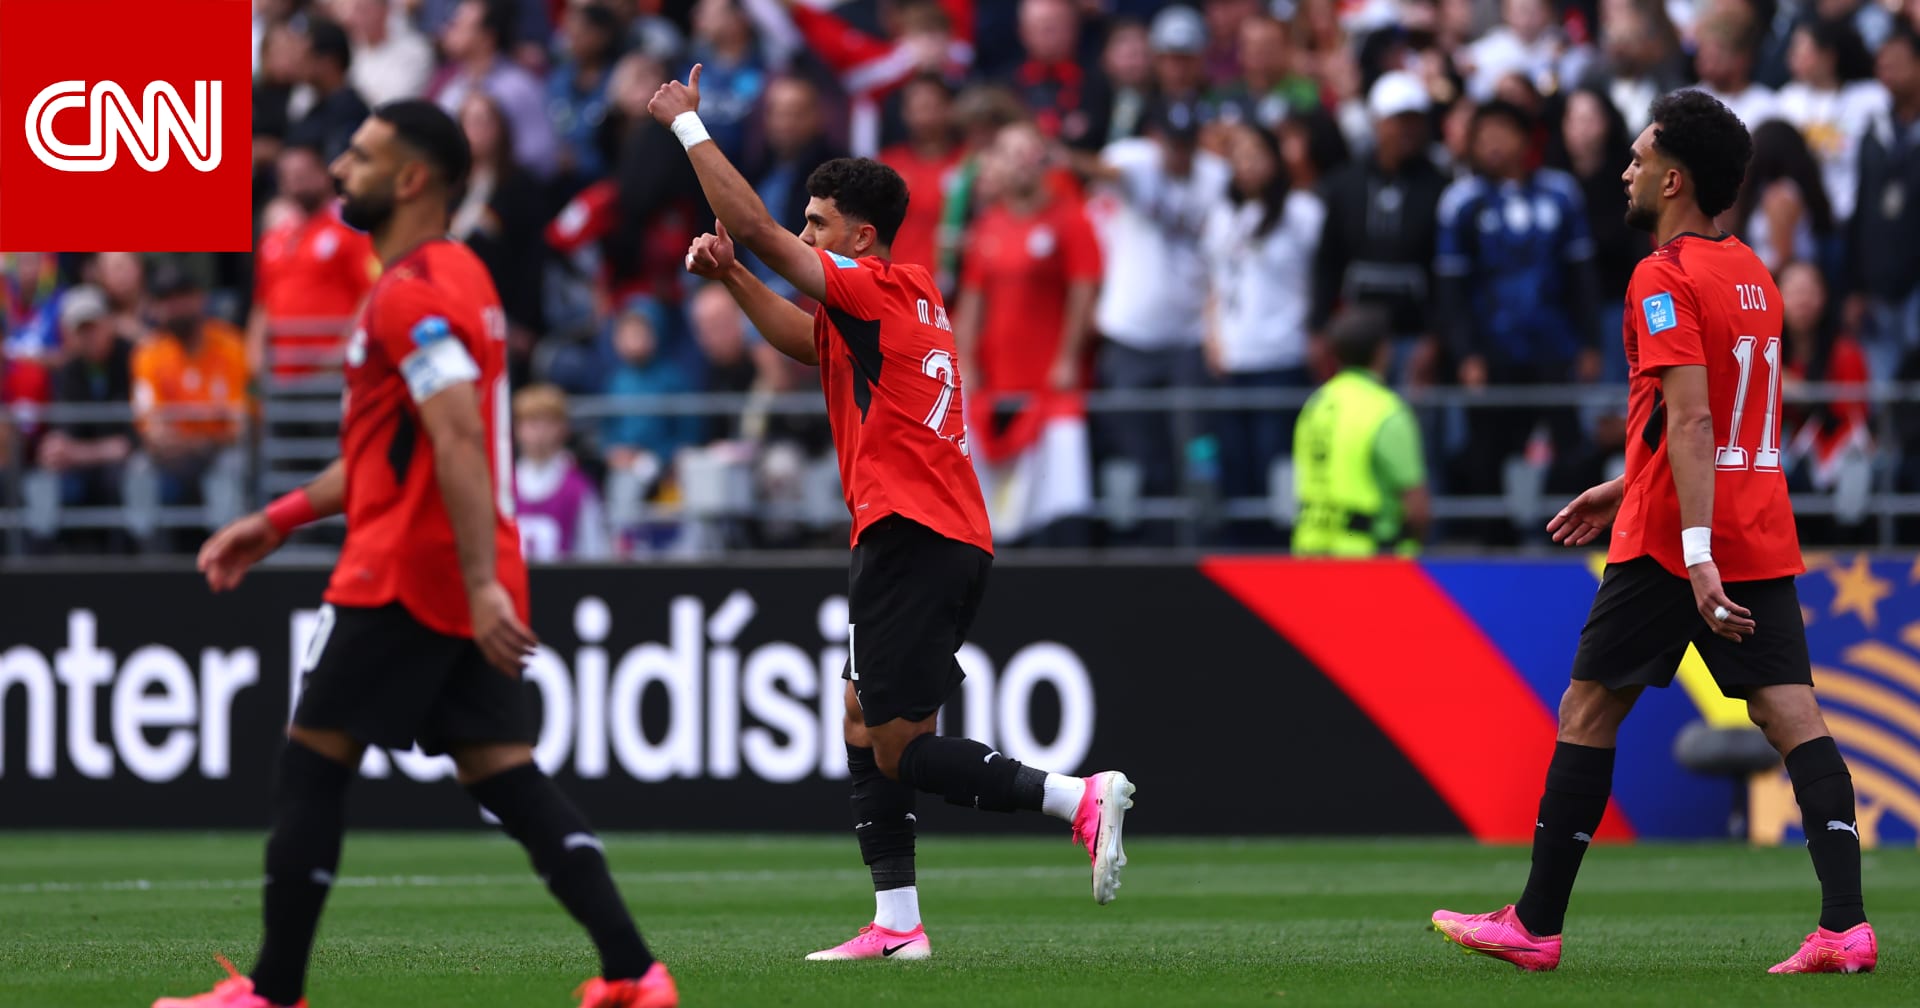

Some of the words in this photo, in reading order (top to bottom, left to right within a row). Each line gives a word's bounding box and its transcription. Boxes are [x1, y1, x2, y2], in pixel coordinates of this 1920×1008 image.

[1736, 284, 1767, 311] ZICO
[917, 298, 932, 326] M.
[1715, 335, 1781, 472] 11
